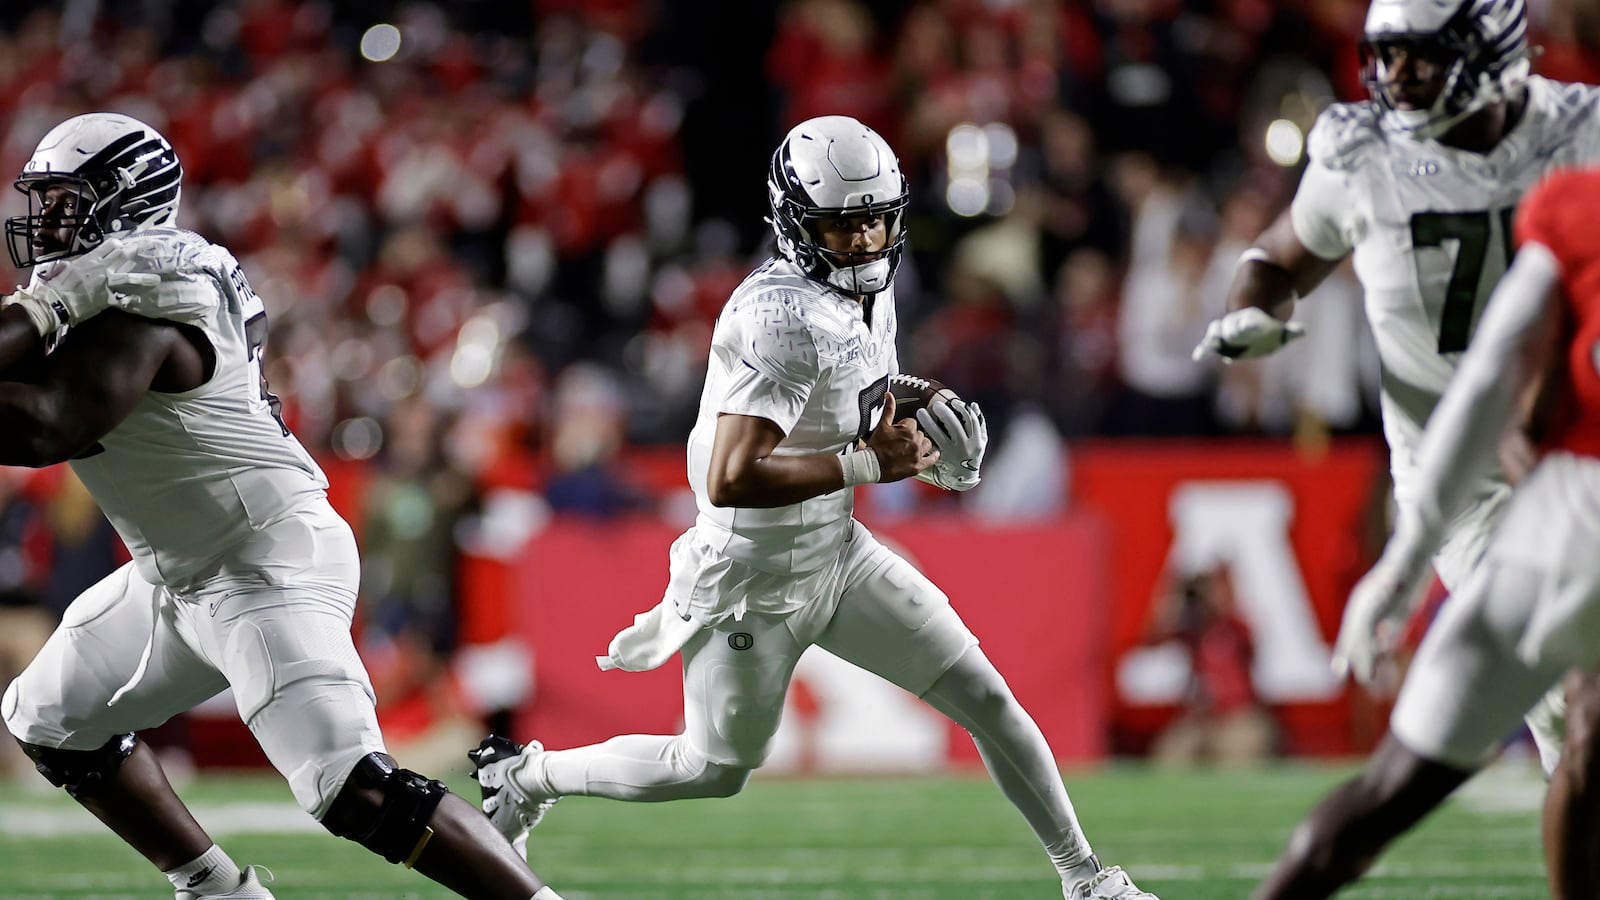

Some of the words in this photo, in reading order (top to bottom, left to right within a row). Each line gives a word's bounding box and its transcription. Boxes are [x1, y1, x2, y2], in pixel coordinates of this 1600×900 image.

[1411, 208, 1513, 353] 7
[728, 632, 754, 650] O
[1116, 480, 1342, 703] A
